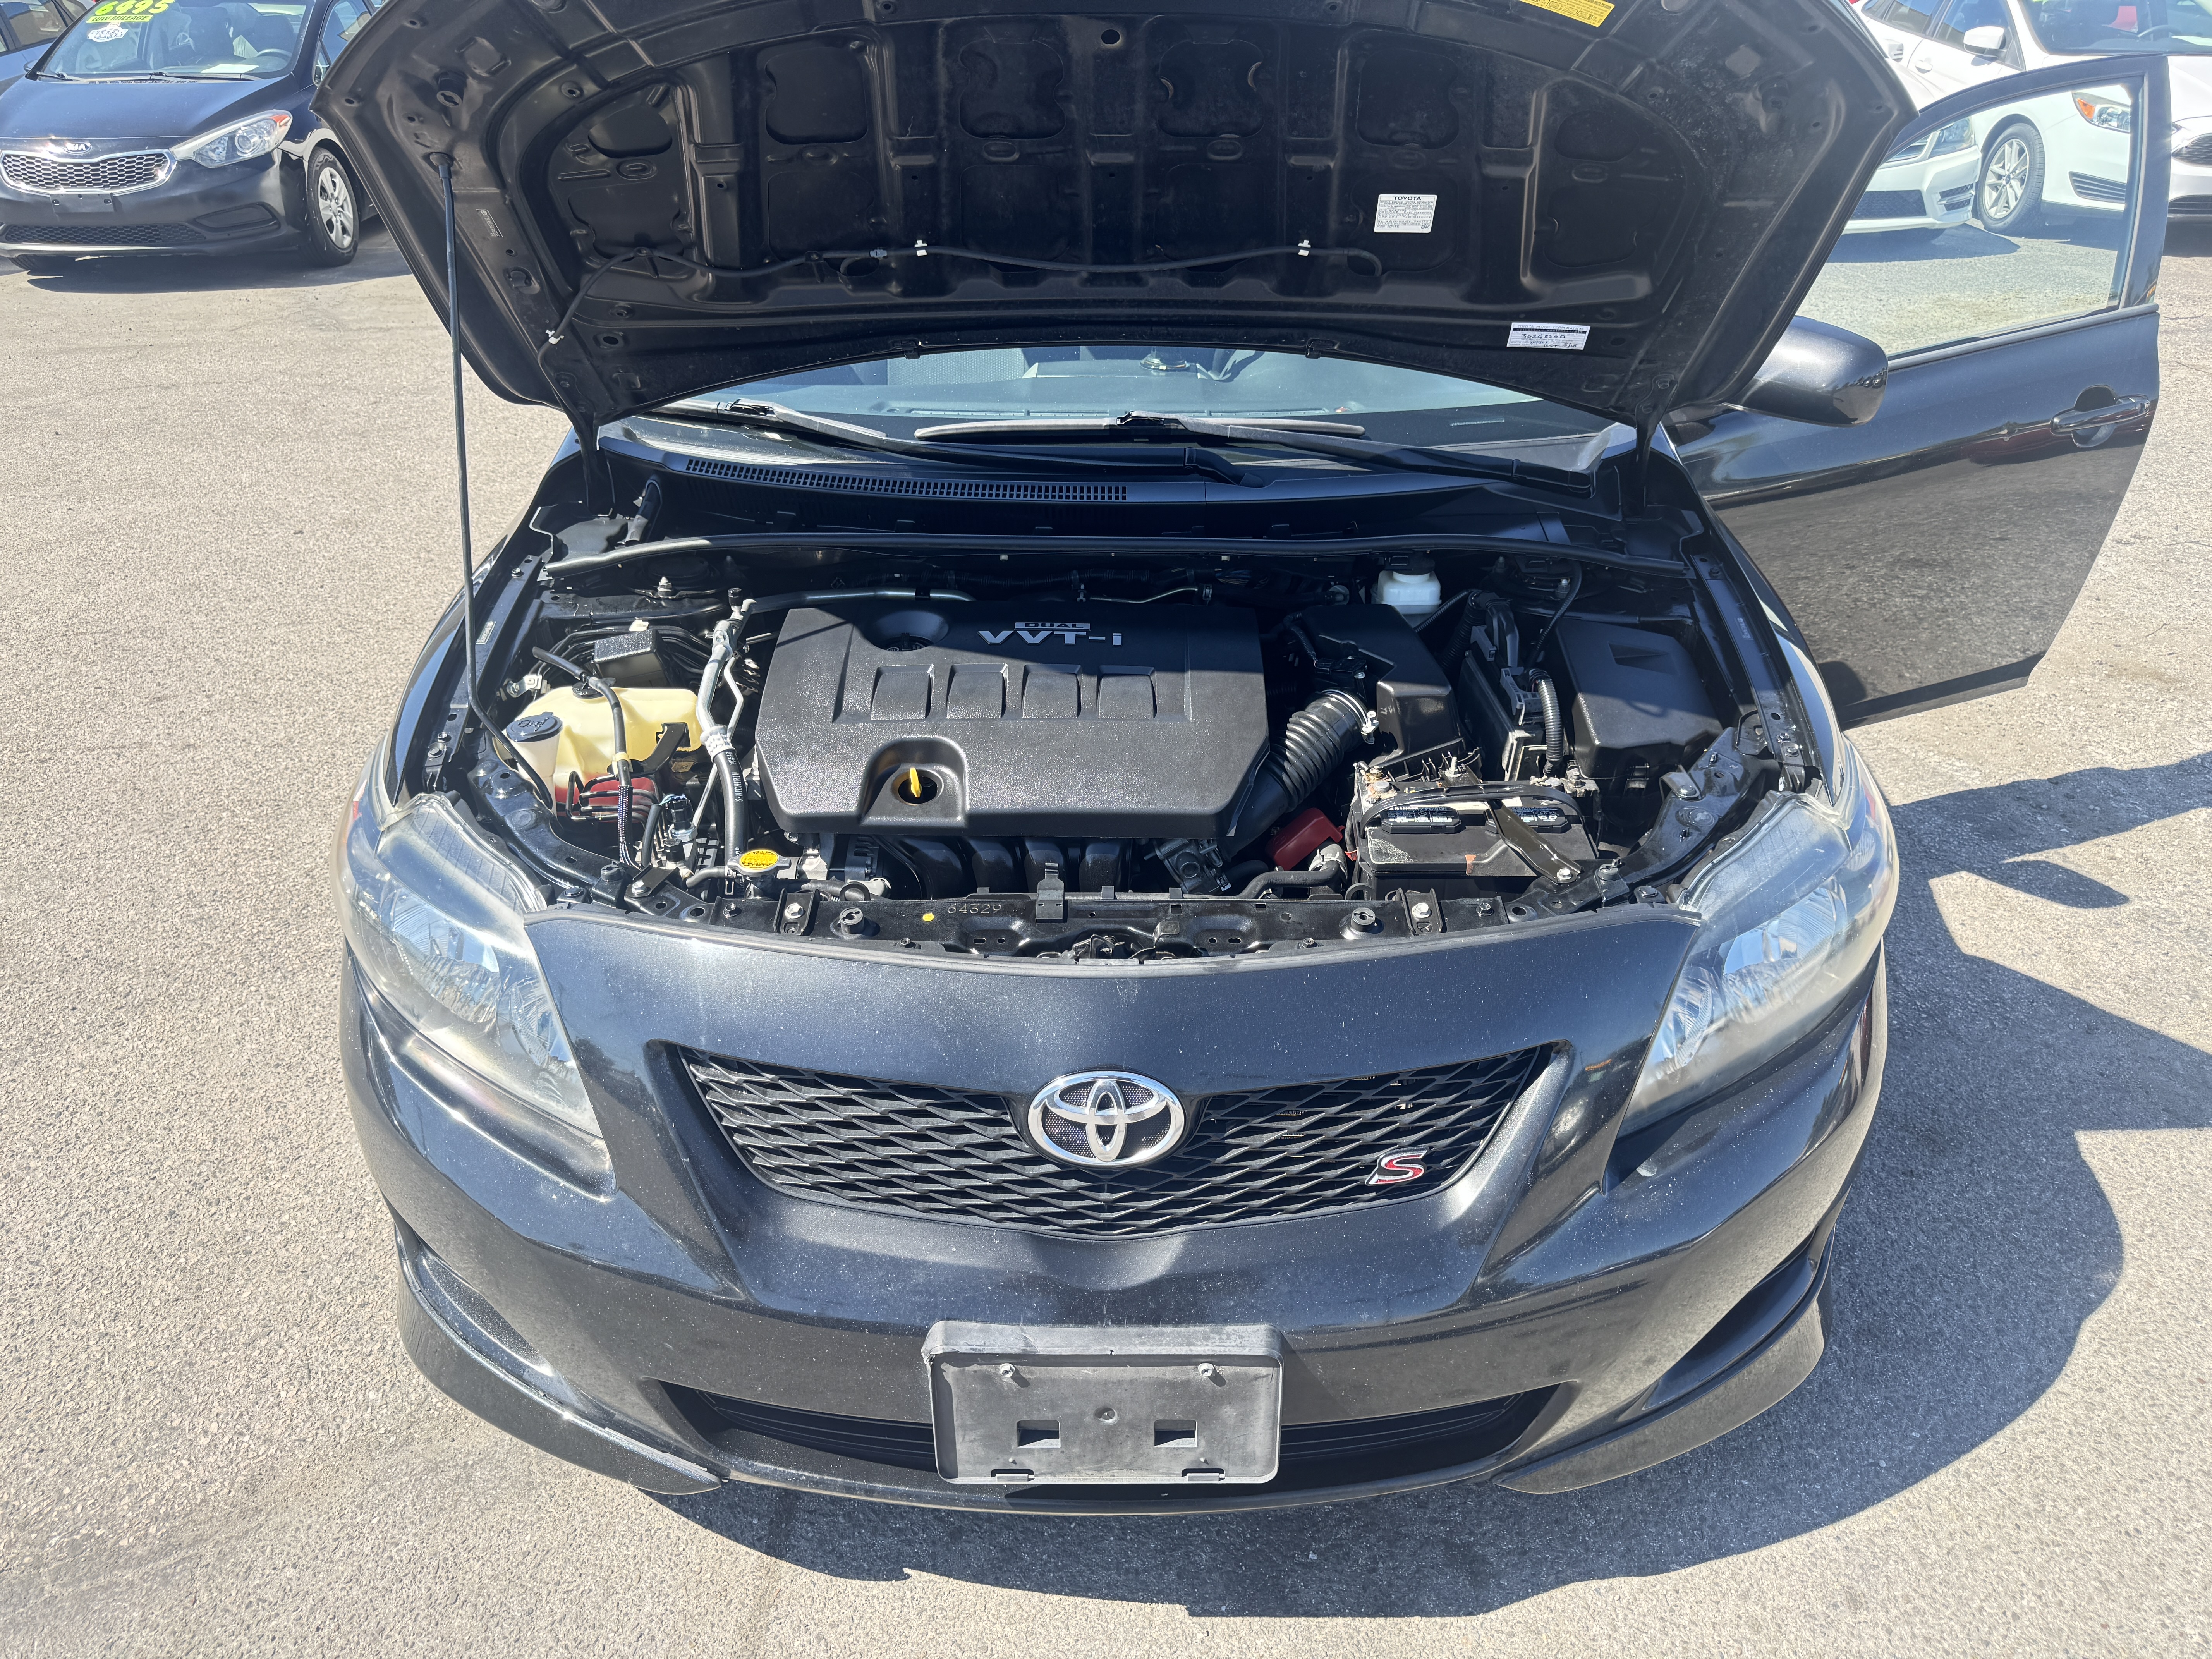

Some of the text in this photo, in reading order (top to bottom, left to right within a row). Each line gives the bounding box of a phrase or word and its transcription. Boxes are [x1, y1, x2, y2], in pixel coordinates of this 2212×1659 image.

[977, 630, 1122, 646] VVT-i
[948, 903, 1001, 914] 64329
[1366, 1147, 1428, 1185] S
